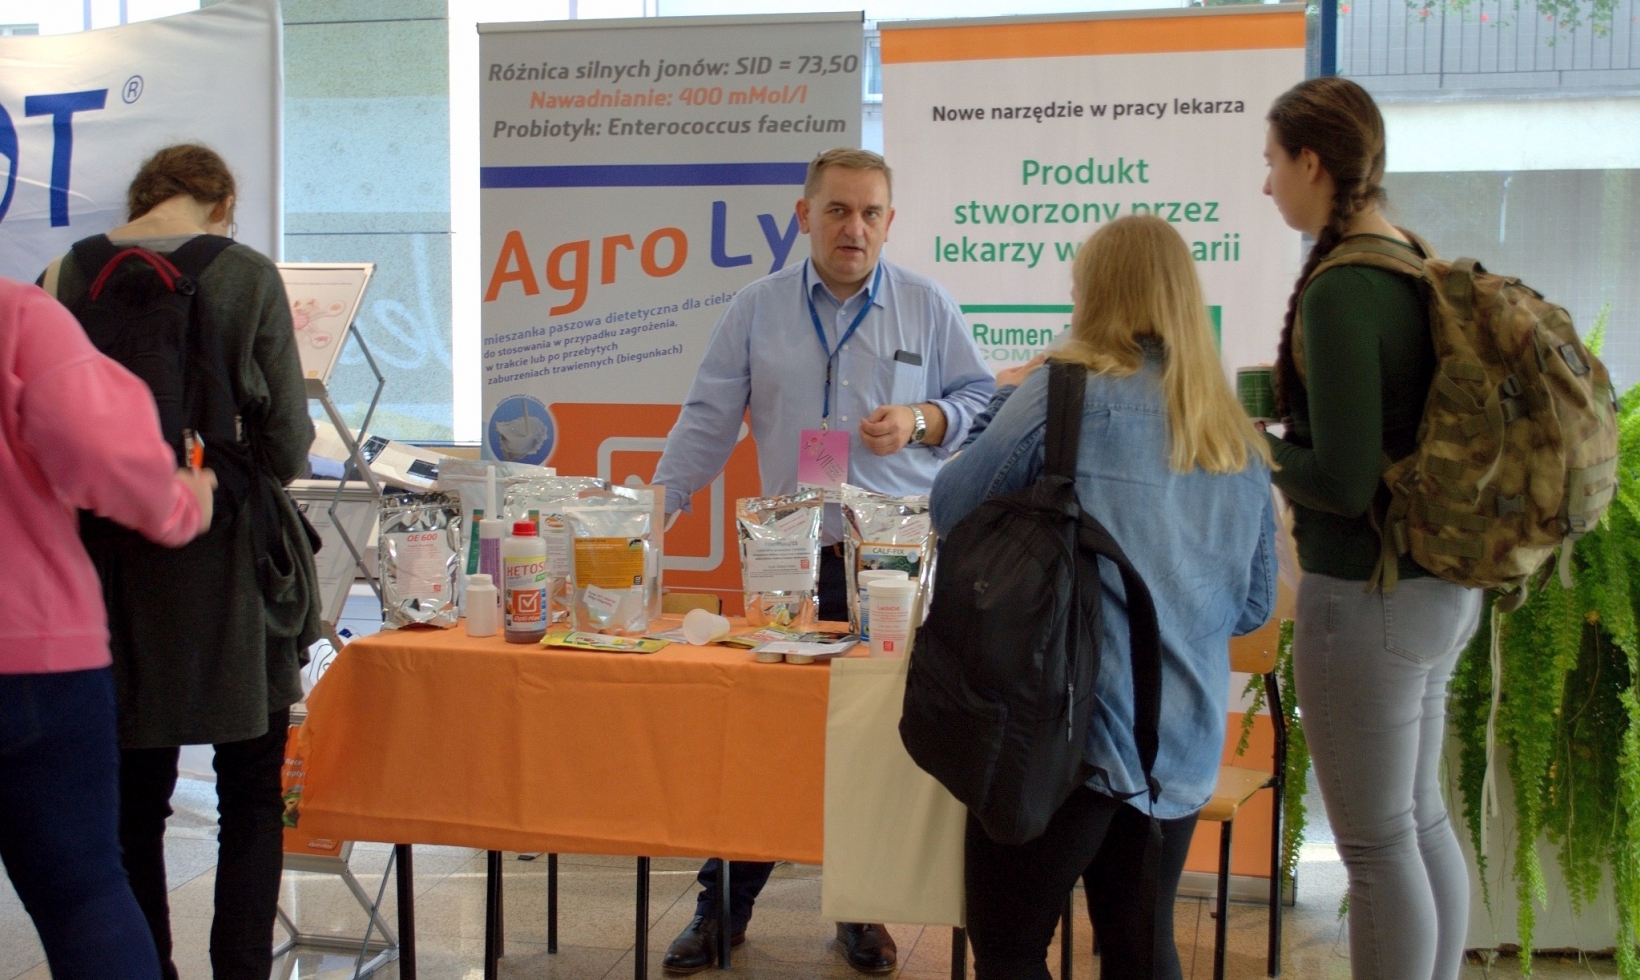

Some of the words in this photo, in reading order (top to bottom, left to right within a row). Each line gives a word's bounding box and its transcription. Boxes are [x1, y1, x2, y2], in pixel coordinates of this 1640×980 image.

[488, 62, 569, 82] Różnica
[575, 60, 650, 83] silnych
[653, 59, 730, 82] jonów:
[735, 56, 772, 75] SID
[798, 55, 858, 76] 73,50
[530, 88, 673, 109] Nawadnianie:
[678, 87, 723, 106] 400
[727, 84, 808, 105] mMol/l
[932, 105, 985, 122] Nowe
[991, 101, 1084, 123] narzędzie
[1089, 103, 1107, 117] w
[1112, 100, 1167, 120] pracy
[1173, 98, 1245, 115] lekarza
[493, 118, 601, 142] Probiotyk:
[608, 117, 751, 135] Enterococcus
[758, 114, 846, 133] faecium
[0, 88, 108, 228] T
[1022, 157, 1149, 185] Produkt
[954, 200, 1120, 225] stworzony
[935, 236, 1044, 269] lekarzy
[483, 226, 688, 316] Agro
[484, 327, 545, 345] mieszanka
[549, 318, 602, 337] paszowa
[605, 303, 678, 324] dietetyczna
[682, 298, 701, 310] dla
[484, 350, 495, 359] do
[498, 340, 551, 356] stosowania
[564, 329, 617, 347] przypadku
[619, 319, 678, 336] zagrożenia,
[486, 364, 493, 372] w
[495, 358, 528, 370] trakcie
[531, 354, 545, 364] lub
[547, 354, 560, 364] po
[562, 341, 618, 361] przebytych
[487, 367, 550, 385] zaburzeniach
[552, 356, 613, 374] trawiennych
[616, 343, 683, 365] (biegunkach)
[421, 533, 437, 541] 600
[872, 547, 904, 555] CALF-FIX
